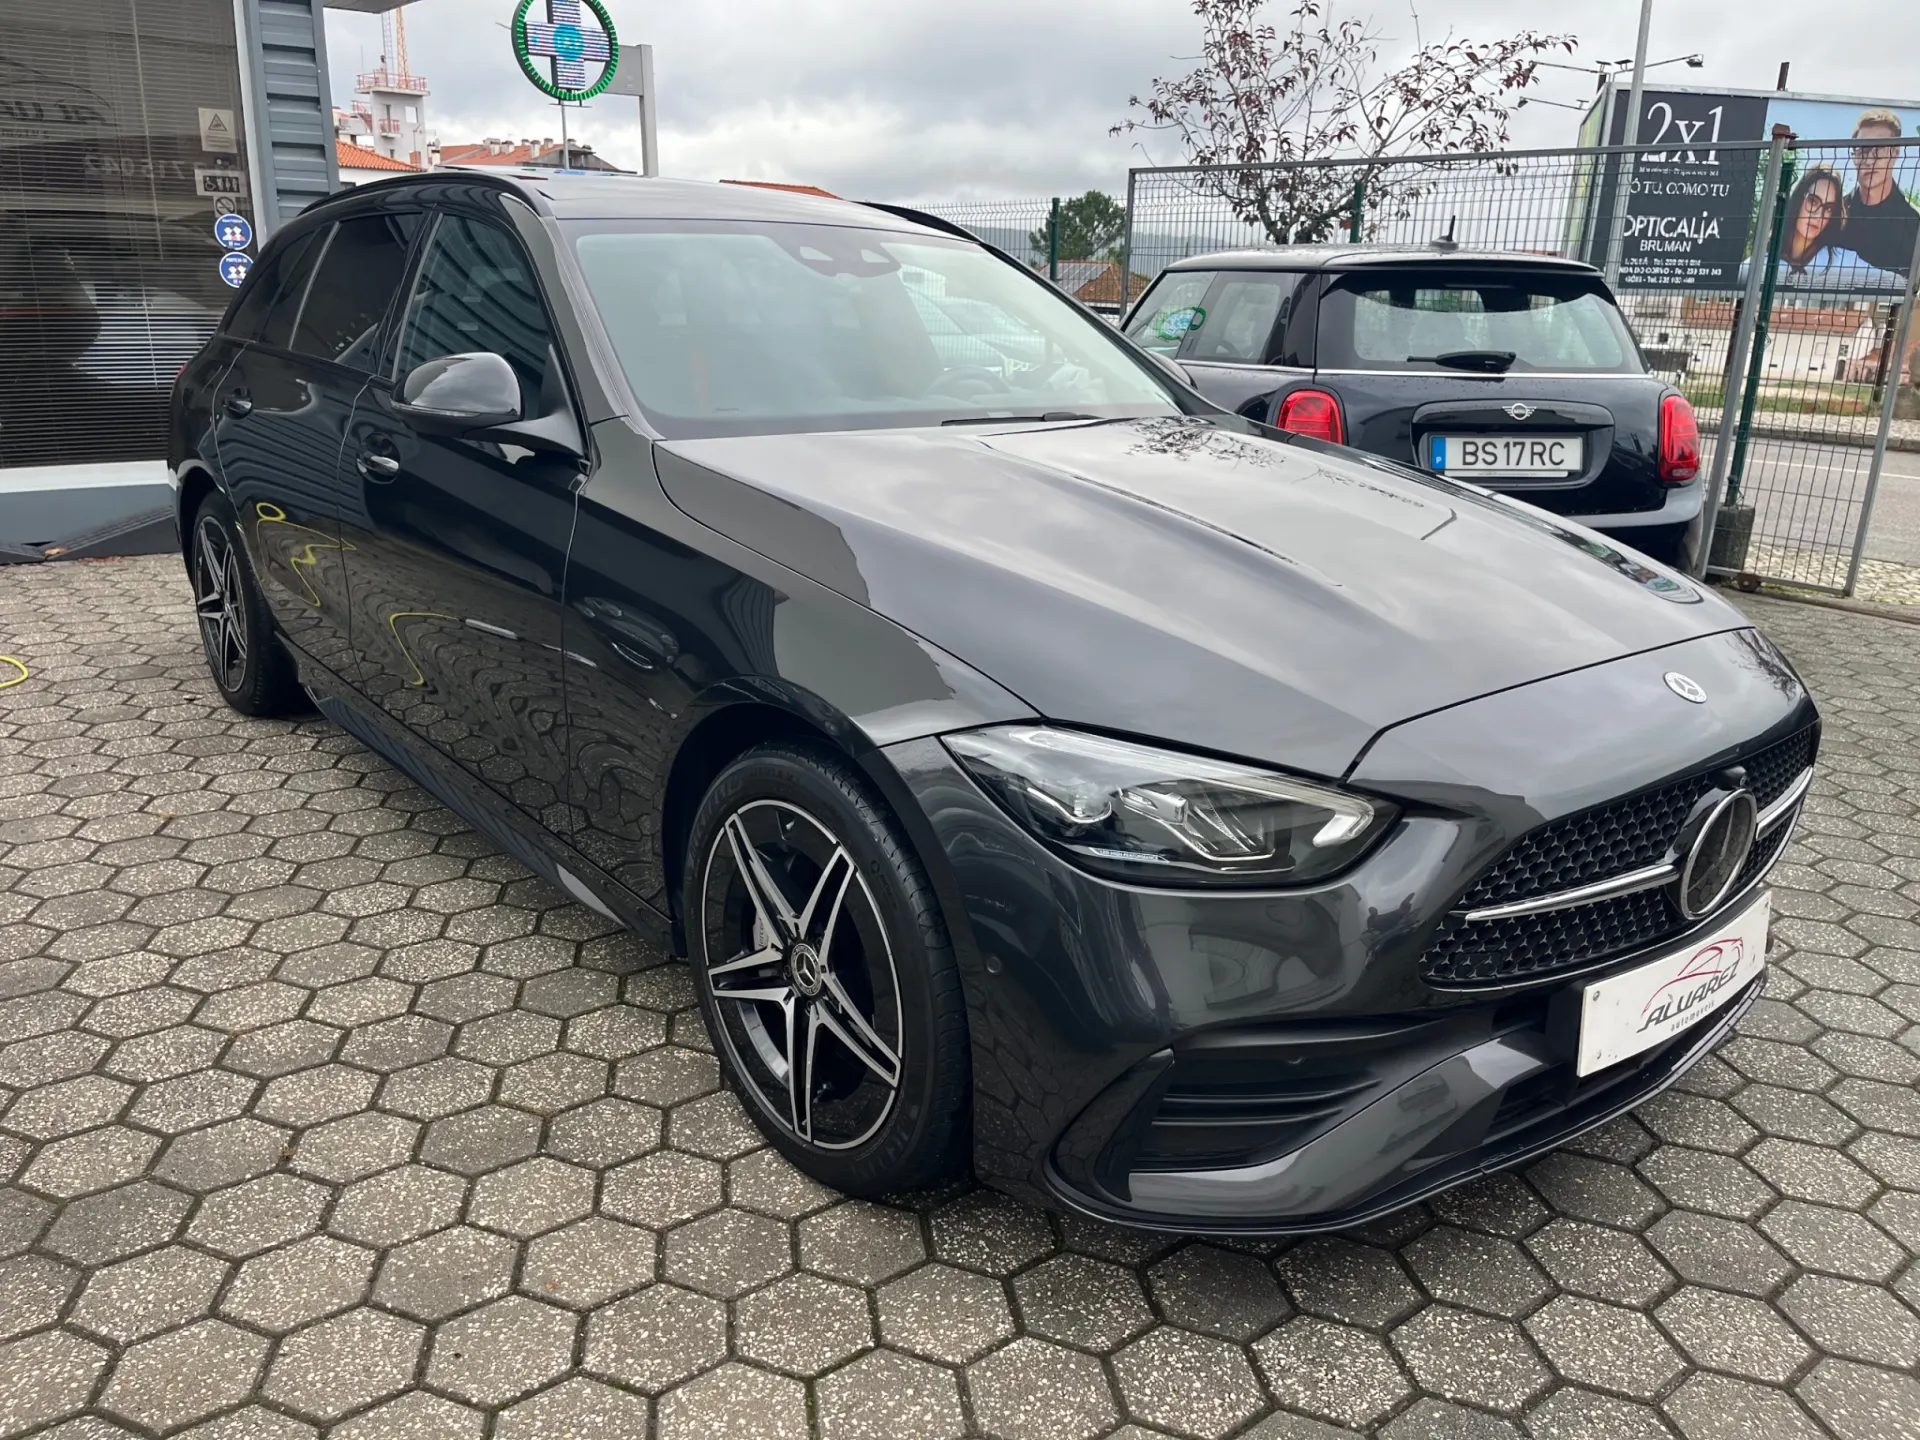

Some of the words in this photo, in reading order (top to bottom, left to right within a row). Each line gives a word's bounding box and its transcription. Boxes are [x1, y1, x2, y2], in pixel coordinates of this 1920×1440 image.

[1640, 101, 1723, 166] 2x1
[1639, 239, 1692, 253] BRUMAN
[1435, 456, 1442, 464] P
